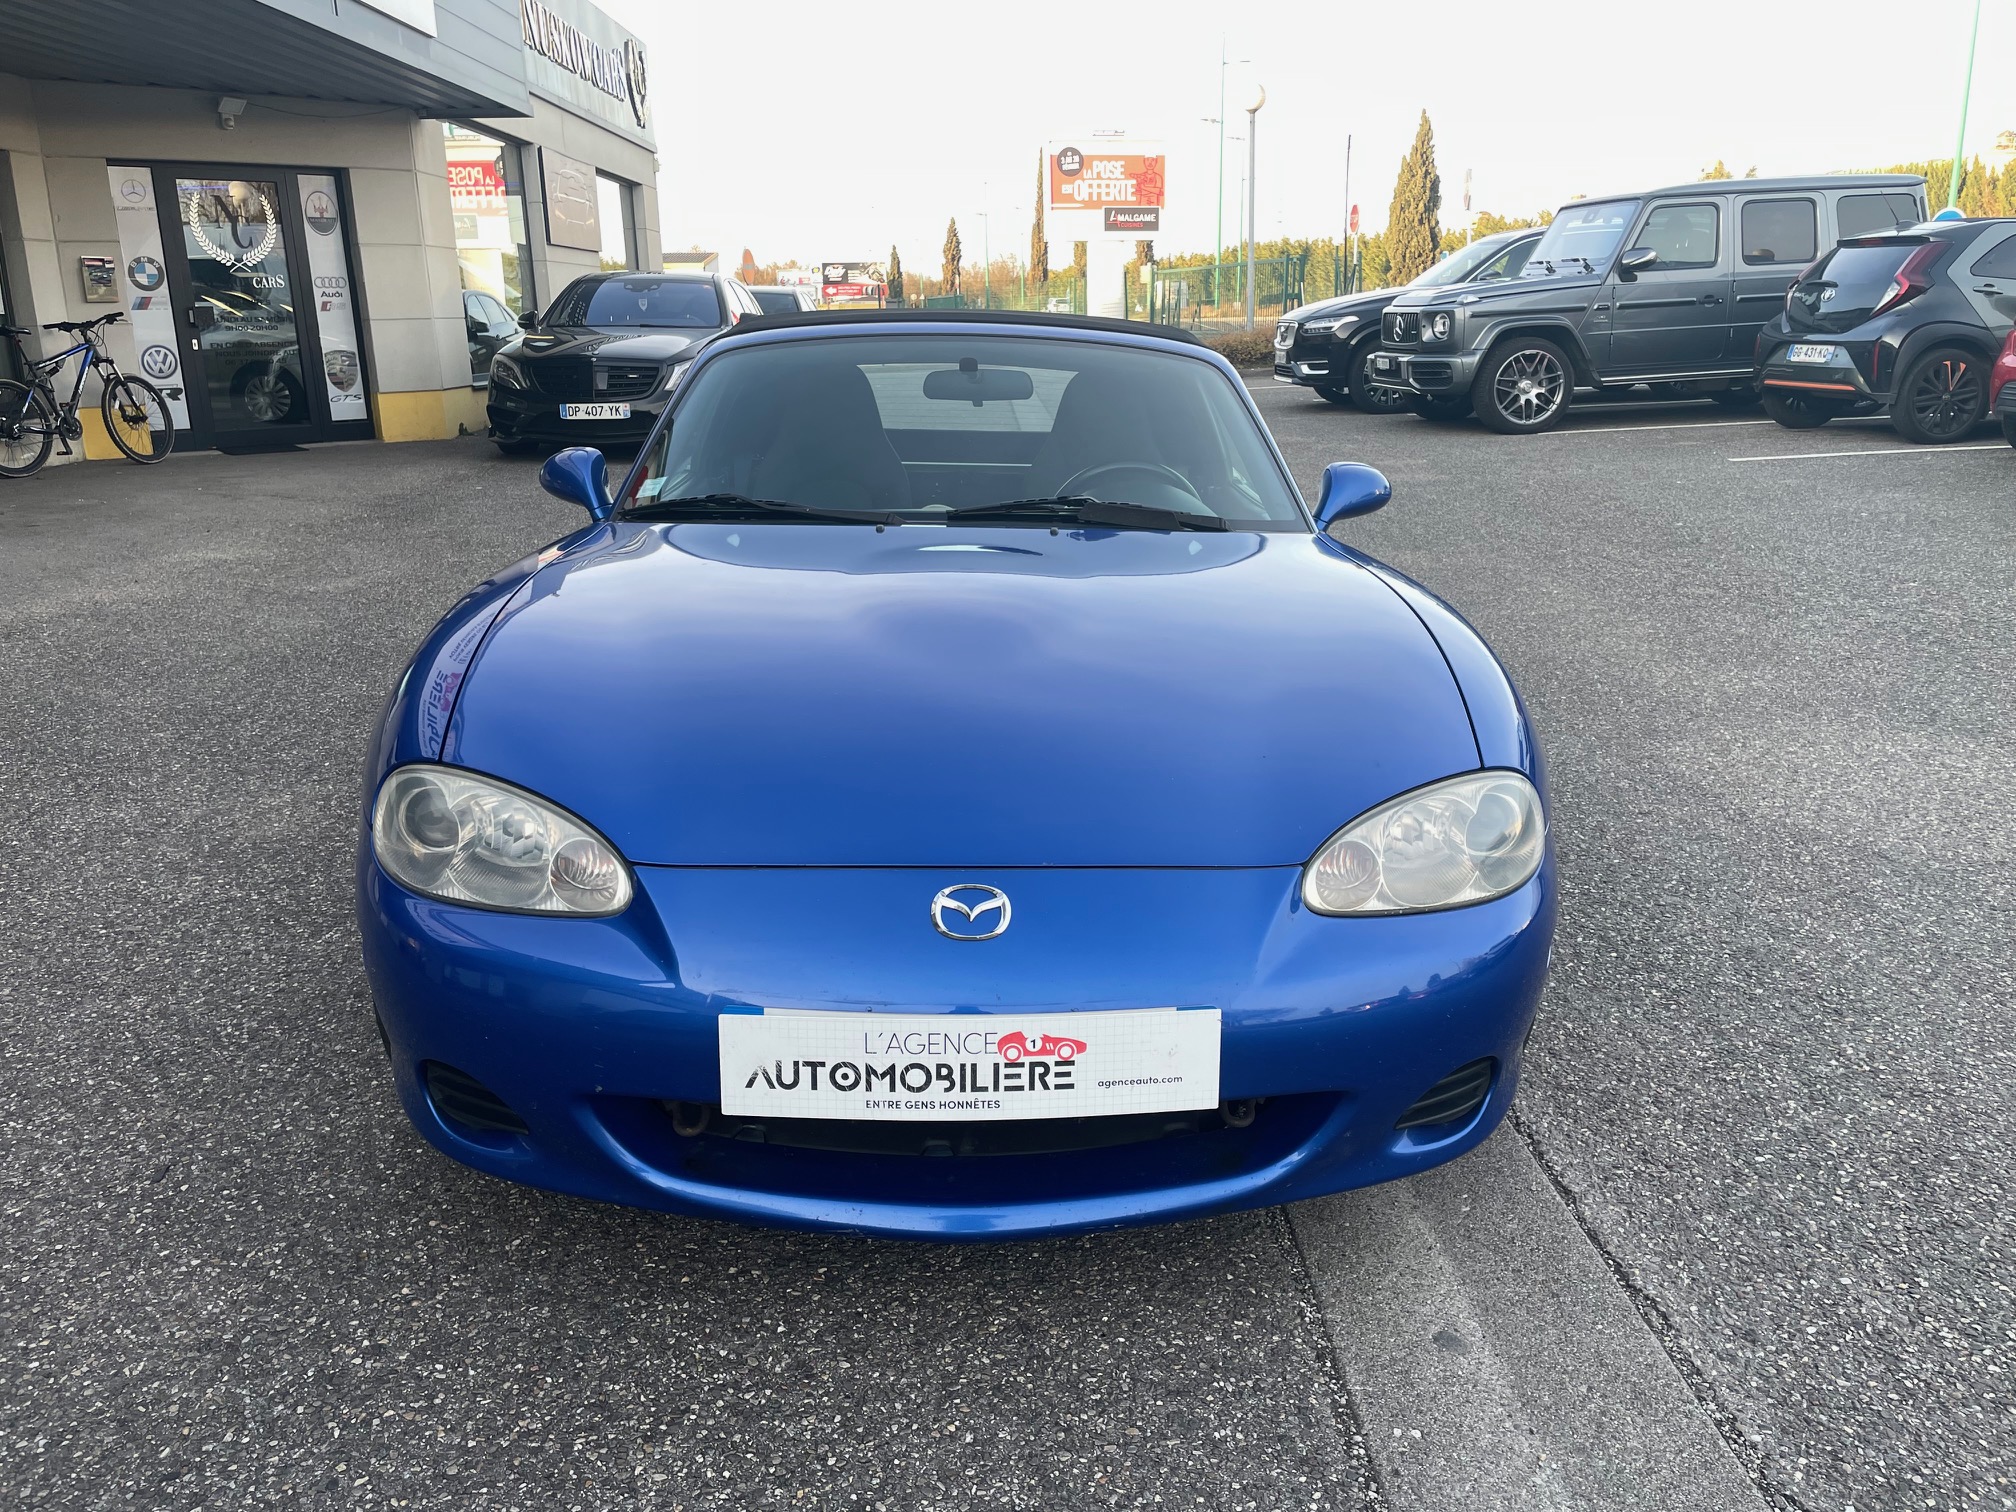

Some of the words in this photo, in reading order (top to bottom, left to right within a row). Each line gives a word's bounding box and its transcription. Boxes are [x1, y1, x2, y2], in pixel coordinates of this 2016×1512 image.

[1092, 161, 1125, 179] POSE
[1073, 180, 1137, 201] OFFERTE
[330, 394, 362, 402] GTS
[568, 406, 621, 416] DP-407-YK
[865, 1032, 999, 1055] L'AGENCE
[745, 1060, 1076, 1093] AUTOMOBILIERE
[1098, 1076, 1183, 1089] agenceauto.com
[866, 1100, 901, 1110] ENTRE
[905, 1100, 936, 1110] GENS
[939, 1097, 1001, 1110] HONNÊTES
